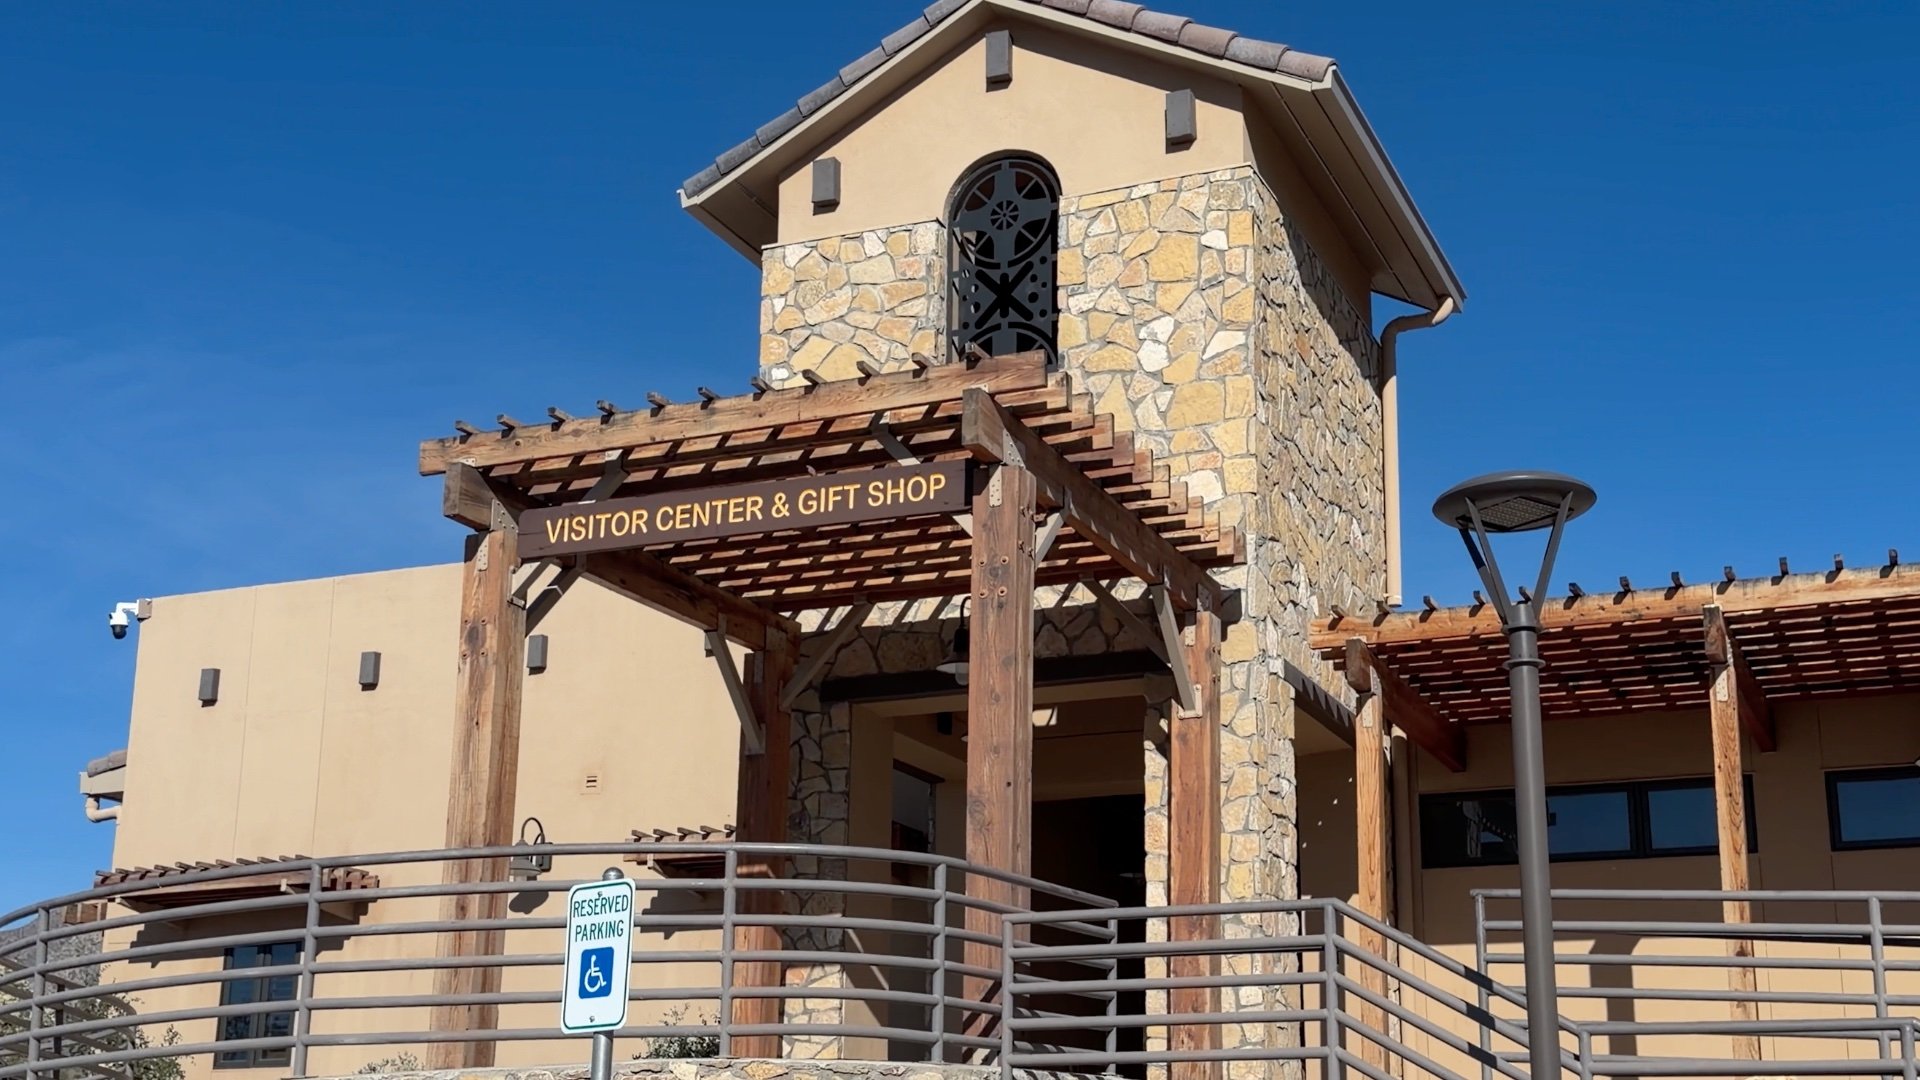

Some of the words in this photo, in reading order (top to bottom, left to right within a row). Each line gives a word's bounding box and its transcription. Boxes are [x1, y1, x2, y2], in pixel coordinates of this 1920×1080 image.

[546, 508, 648, 544] VISITOR
[655, 495, 763, 531] CENTER
[771, 491, 791, 518] &
[798, 483, 861, 516] GIFT
[867, 473, 947, 508] SHOP
[573, 894, 629, 918] RESERVED
[575, 920, 624, 942] PARKING
